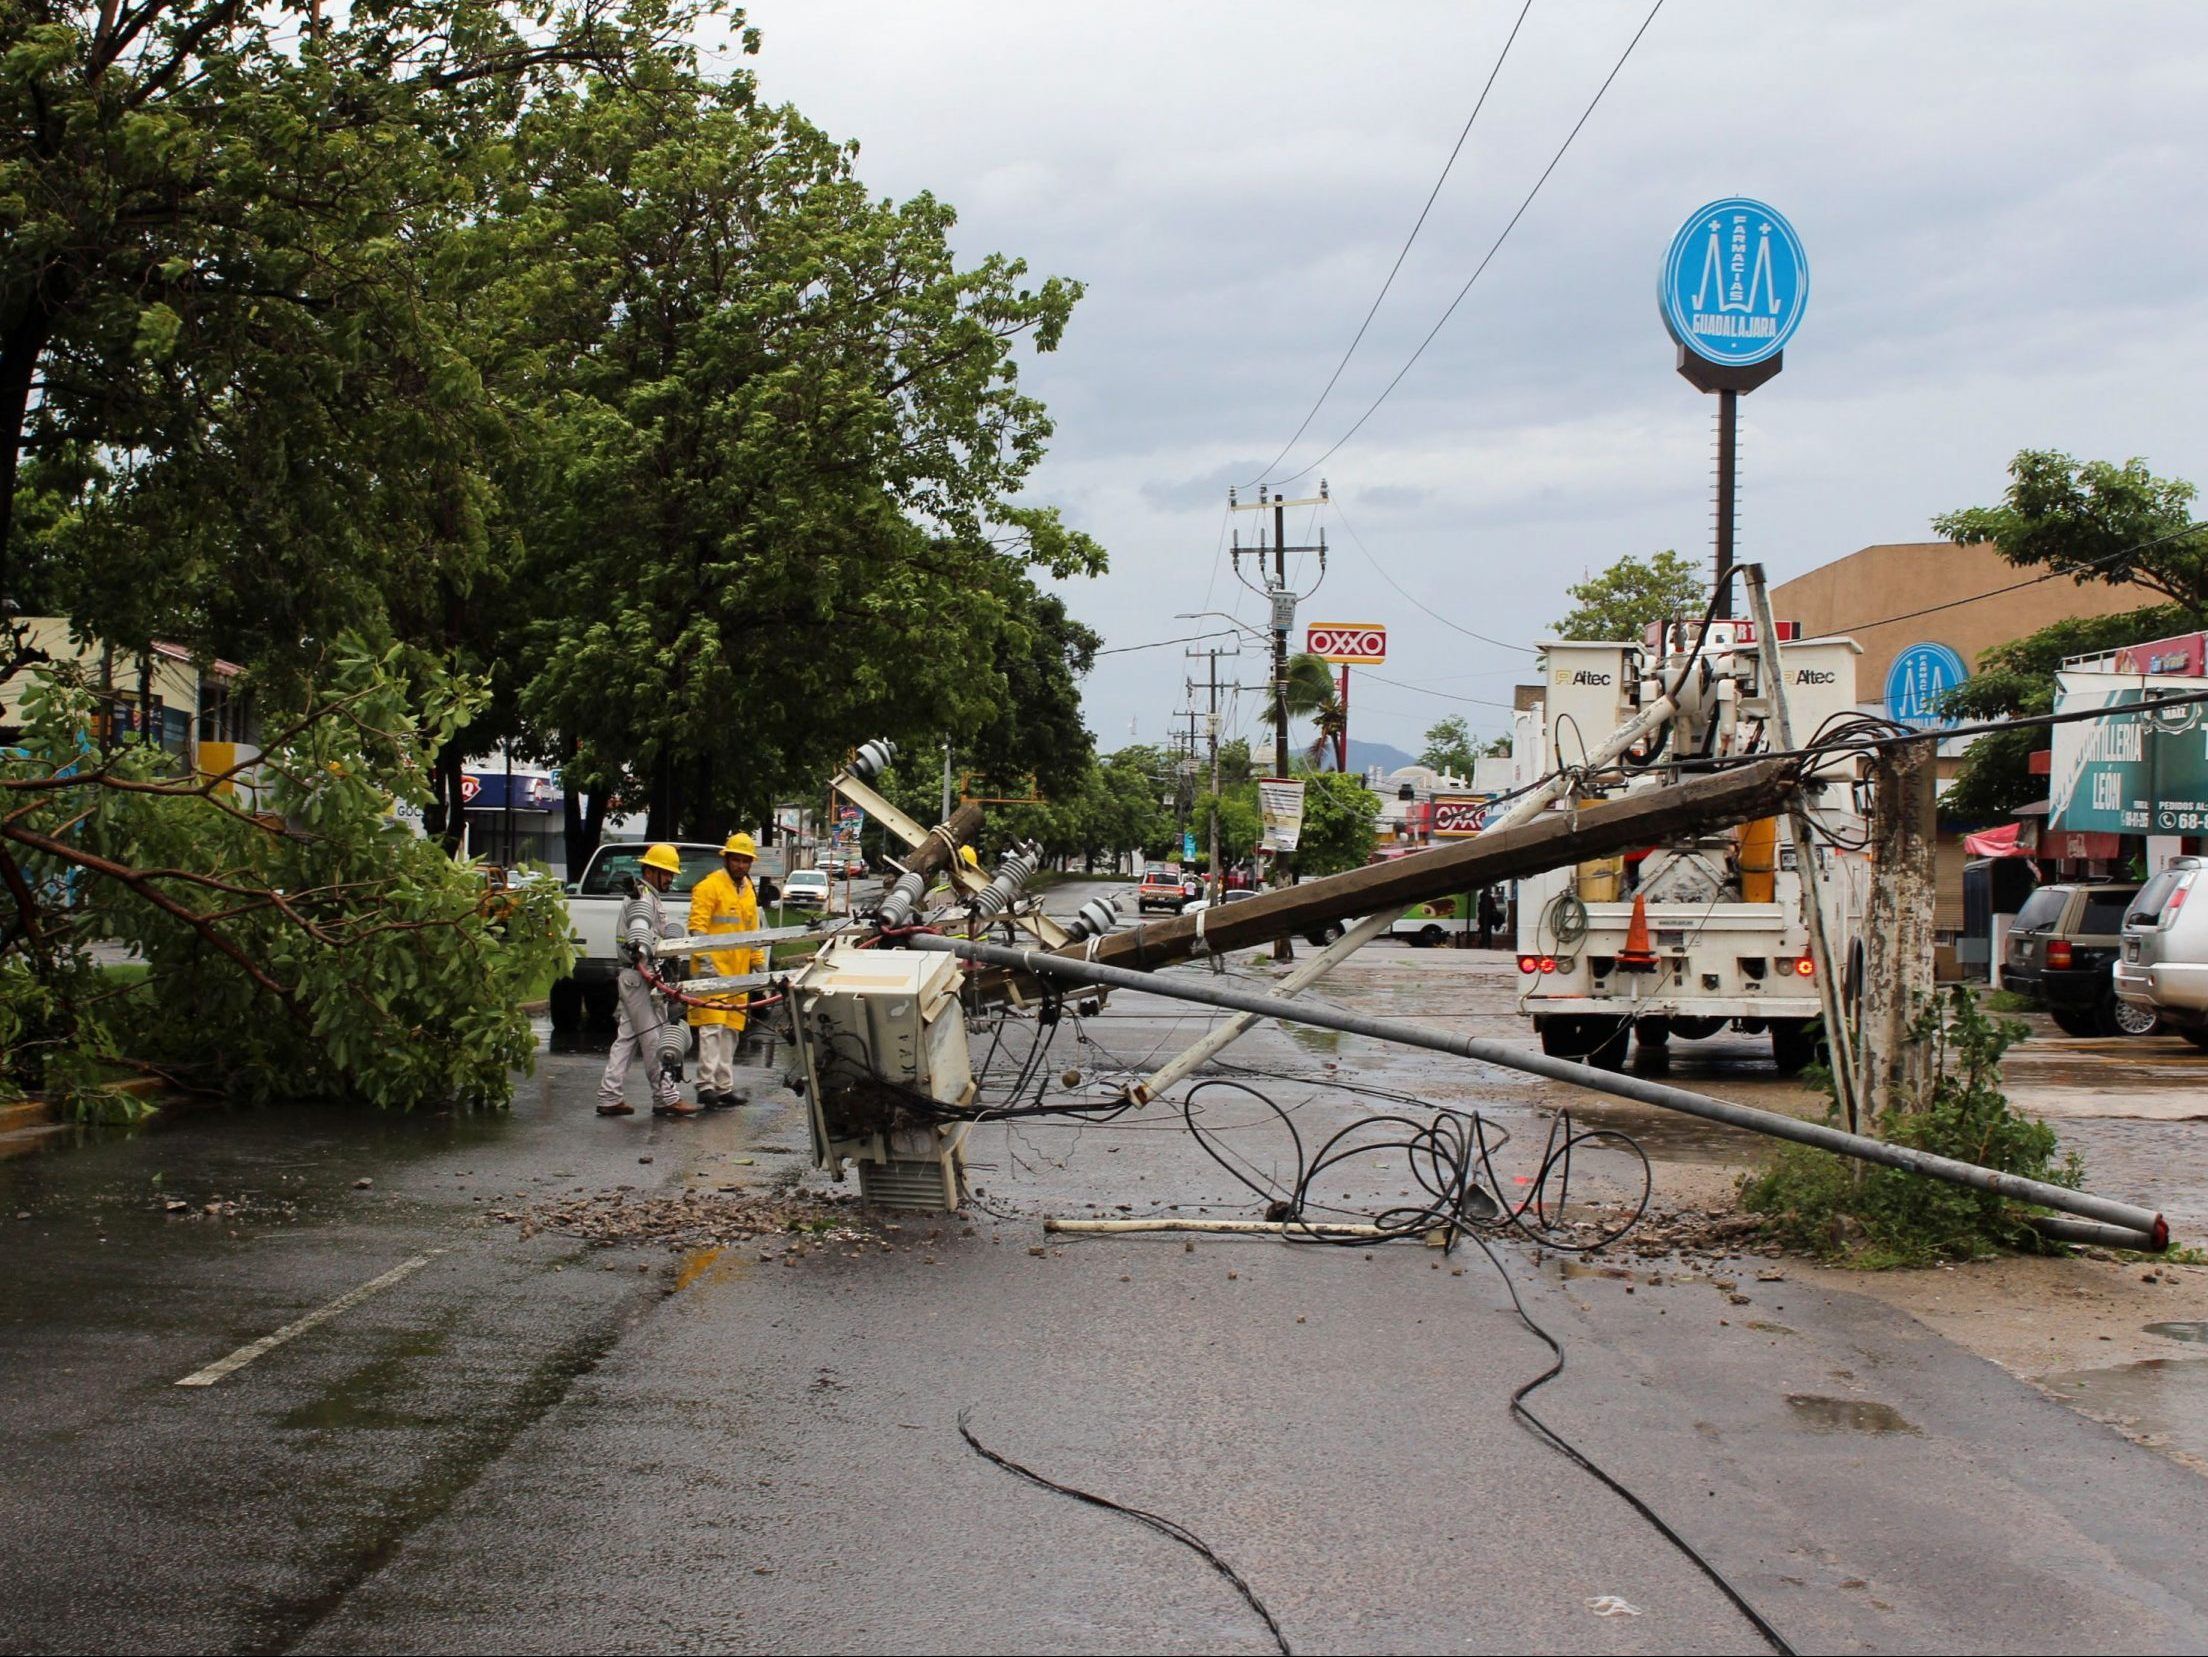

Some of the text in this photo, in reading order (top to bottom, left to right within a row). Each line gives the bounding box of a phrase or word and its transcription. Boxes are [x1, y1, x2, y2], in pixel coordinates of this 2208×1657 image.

[1730, 216, 1747, 301] FARMACIAS
[1693, 313, 1777, 338] GUADALAJARA
[1310, 631, 1384, 655] OXXO
[1573, 670, 1611, 686] Altec
[1796, 669, 1835, 686] Altec
[2092, 764, 2121, 811] LEÓN
[2159, 801, 2194, 811] PEDIDOS
